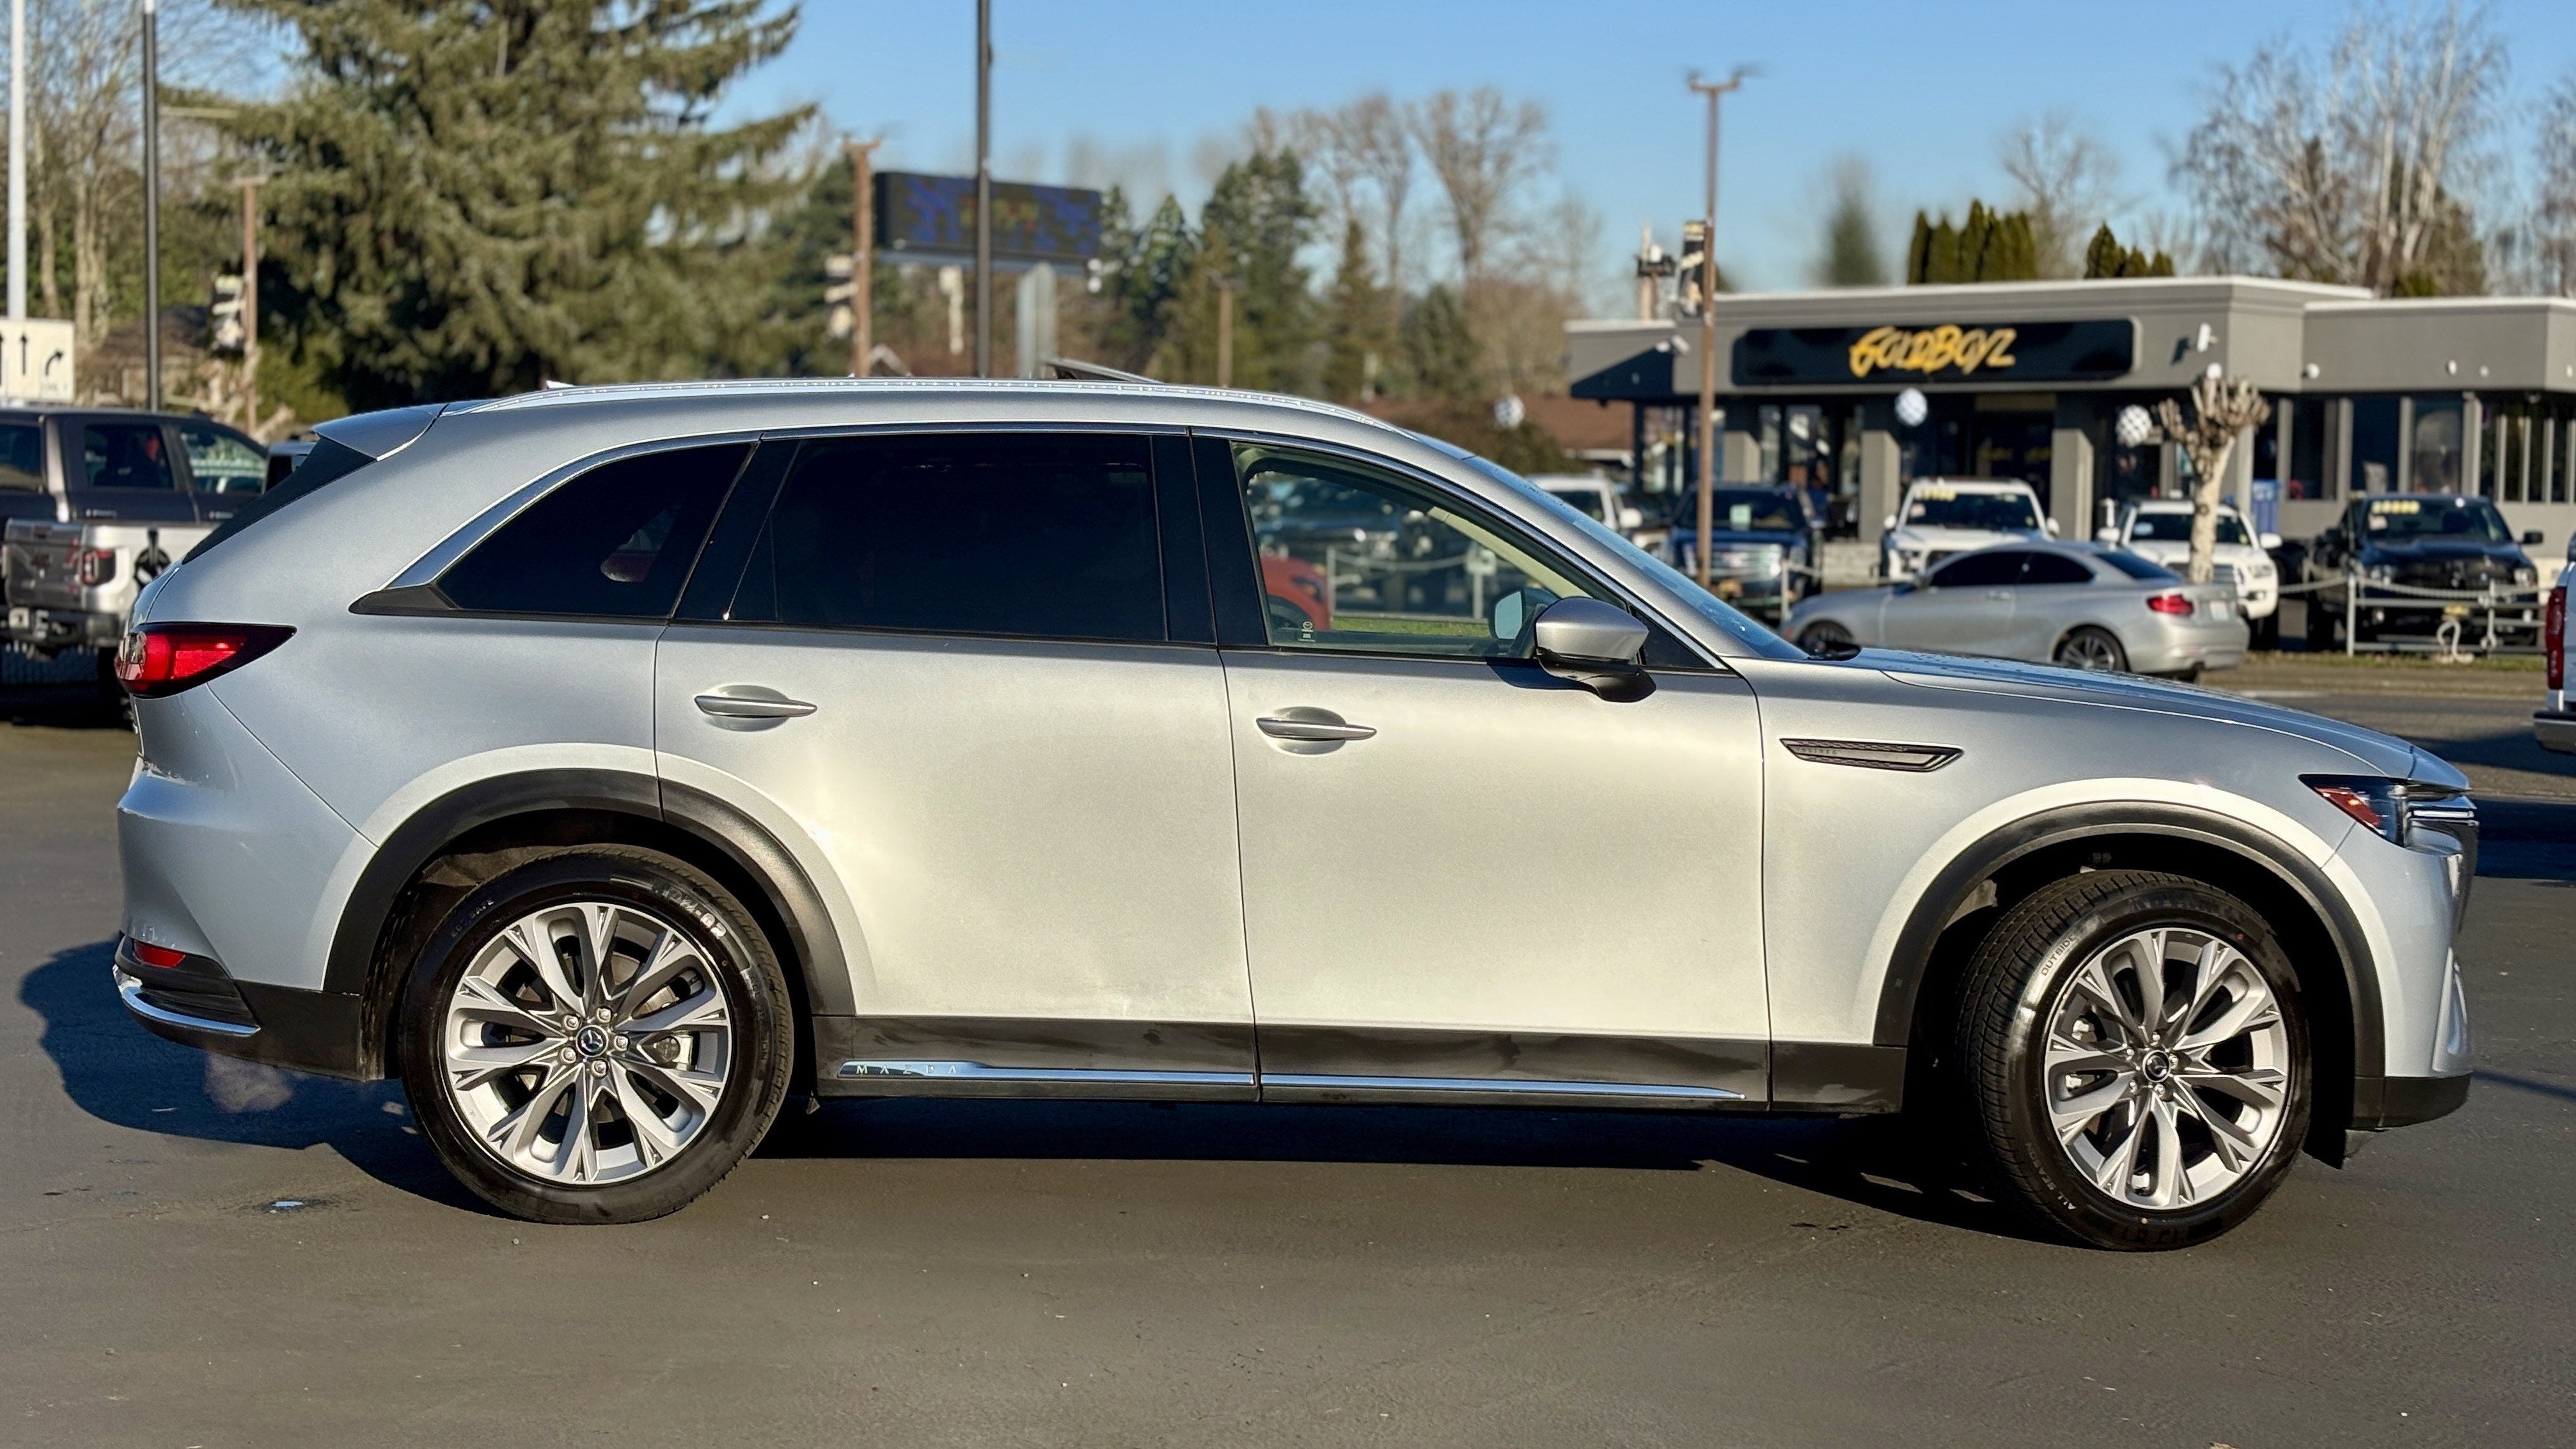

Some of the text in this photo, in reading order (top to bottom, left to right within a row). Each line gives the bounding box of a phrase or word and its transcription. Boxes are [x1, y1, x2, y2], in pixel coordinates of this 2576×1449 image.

[2040, 934, 2076, 976] OUTSIDE
[856, 1065, 957, 1075] MAZDA
[2057, 1191, 2077, 1210] ALL
